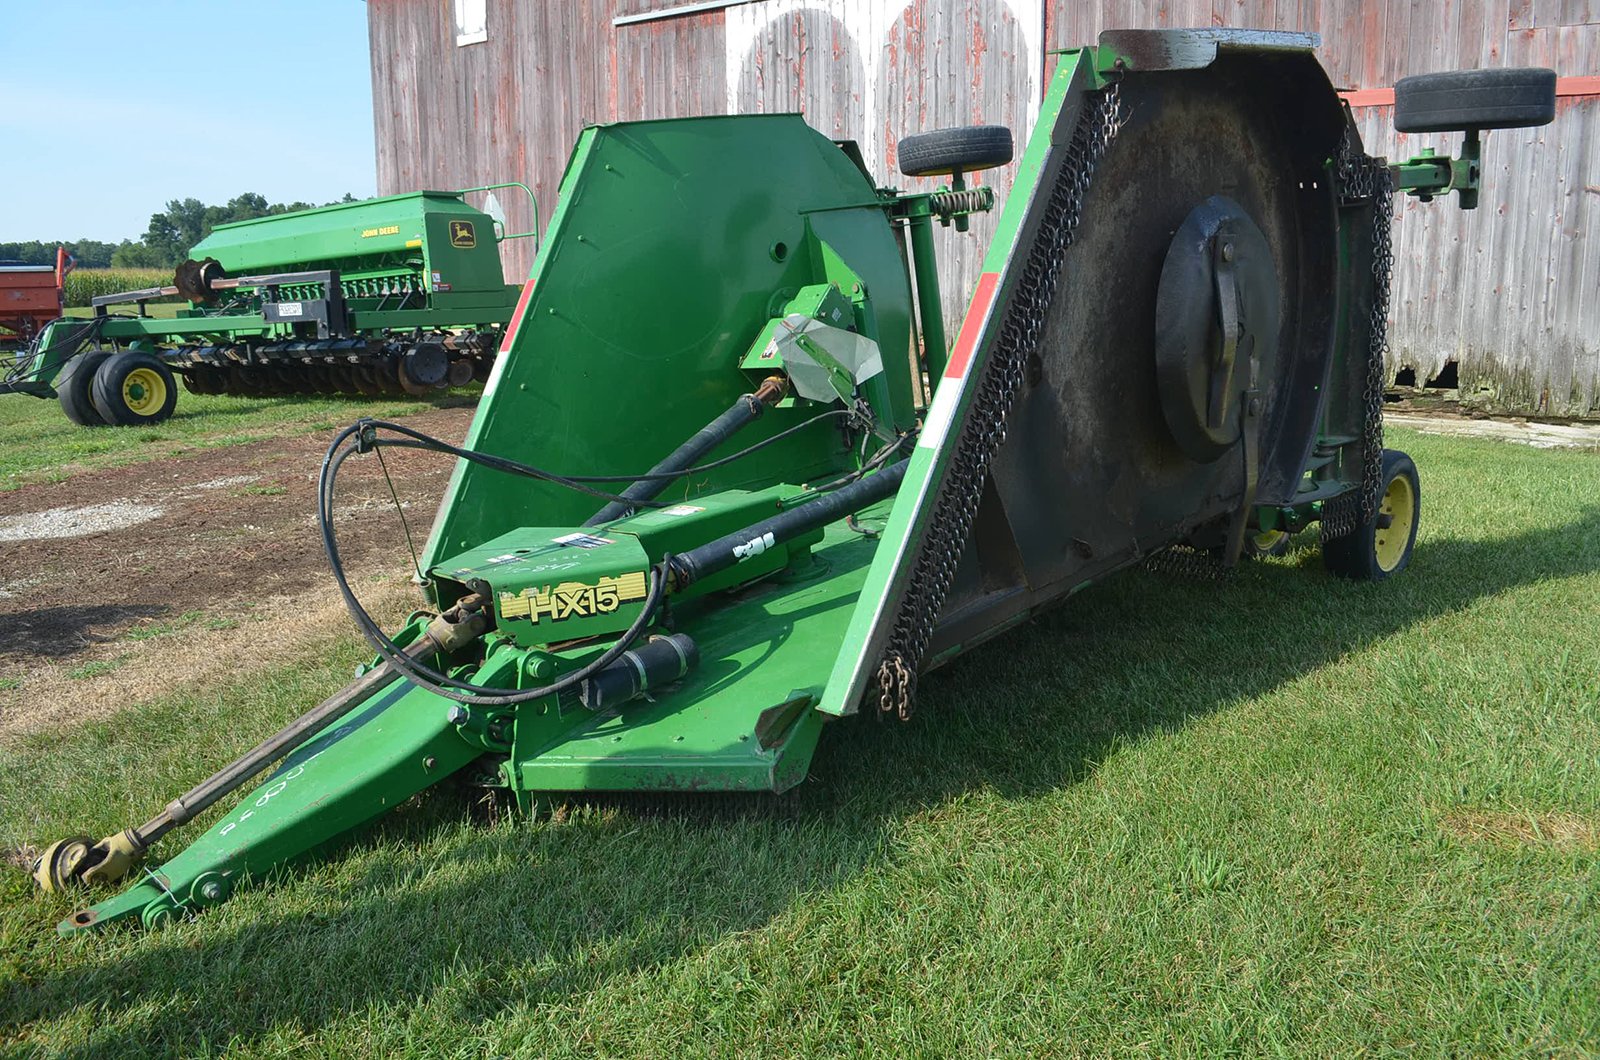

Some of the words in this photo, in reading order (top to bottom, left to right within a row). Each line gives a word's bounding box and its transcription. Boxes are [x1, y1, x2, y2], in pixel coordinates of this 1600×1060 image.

[361, 228, 378, 238] JOHN
[379, 225, 400, 235] DEERE
[528, 584, 620, 624] HX15
